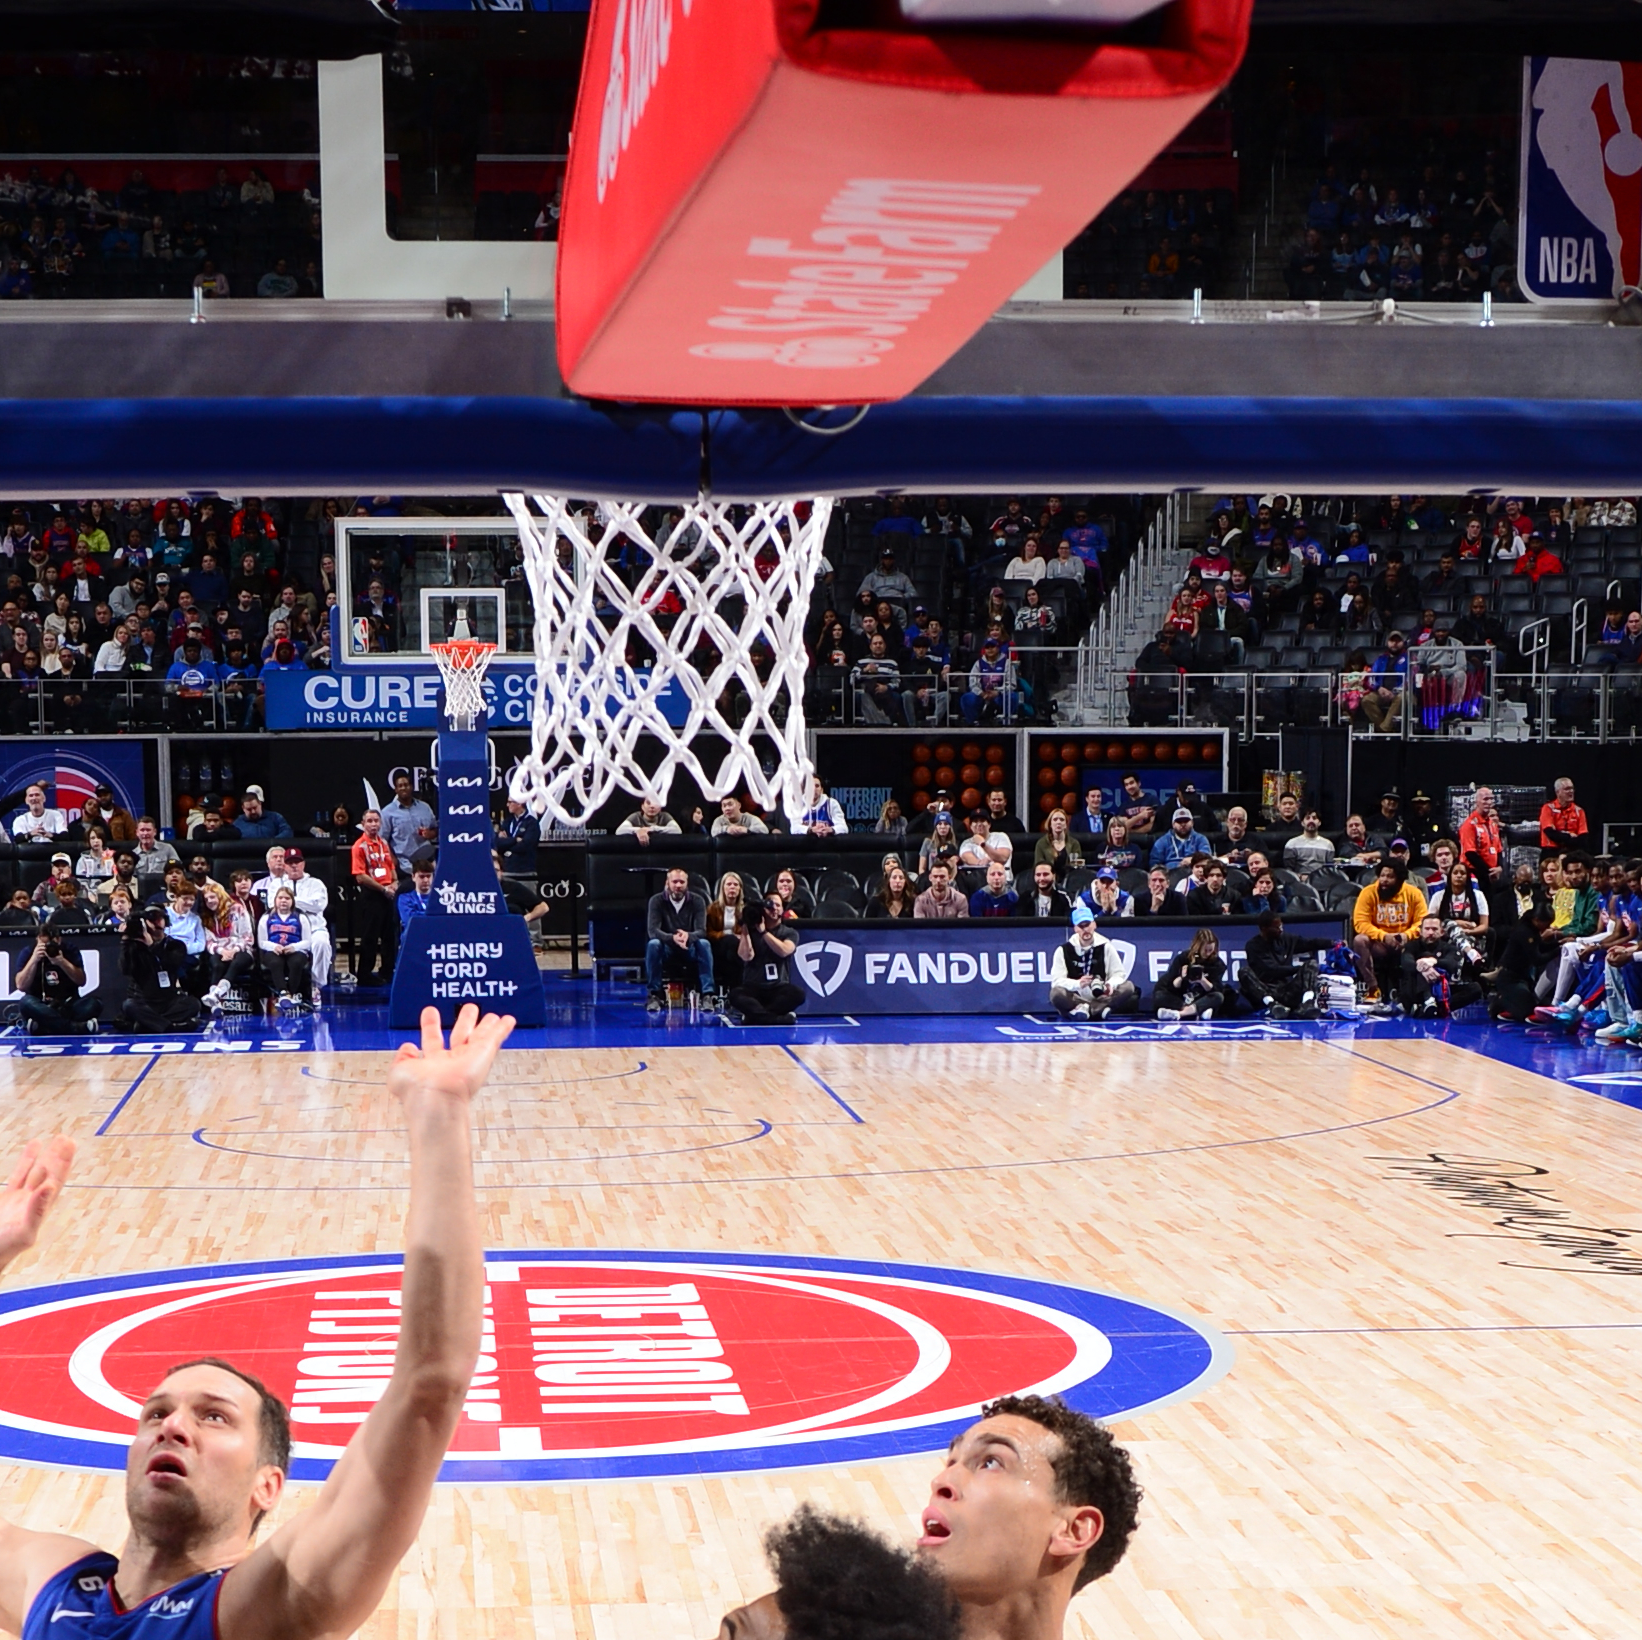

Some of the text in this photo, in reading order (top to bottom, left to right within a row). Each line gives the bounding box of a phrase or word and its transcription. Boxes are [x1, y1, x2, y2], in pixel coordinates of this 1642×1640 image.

[1539, 236, 1598, 284] NBA
[304, 675, 442, 709] CURE
[306, 711, 409, 724] INSURANCE
[830, 787, 893, 801] DIFFERENT
[438, 890, 498, 906] DRAFT
[446, 902, 497, 914] KINGS
[426, 942, 503, 960] HENRY
[431, 962, 488, 979] FORD
[865, 950, 1055, 985] FANDUEL
[432, 980, 519, 998] HEALTH
[525, 1283, 752, 1416] DETROIT
